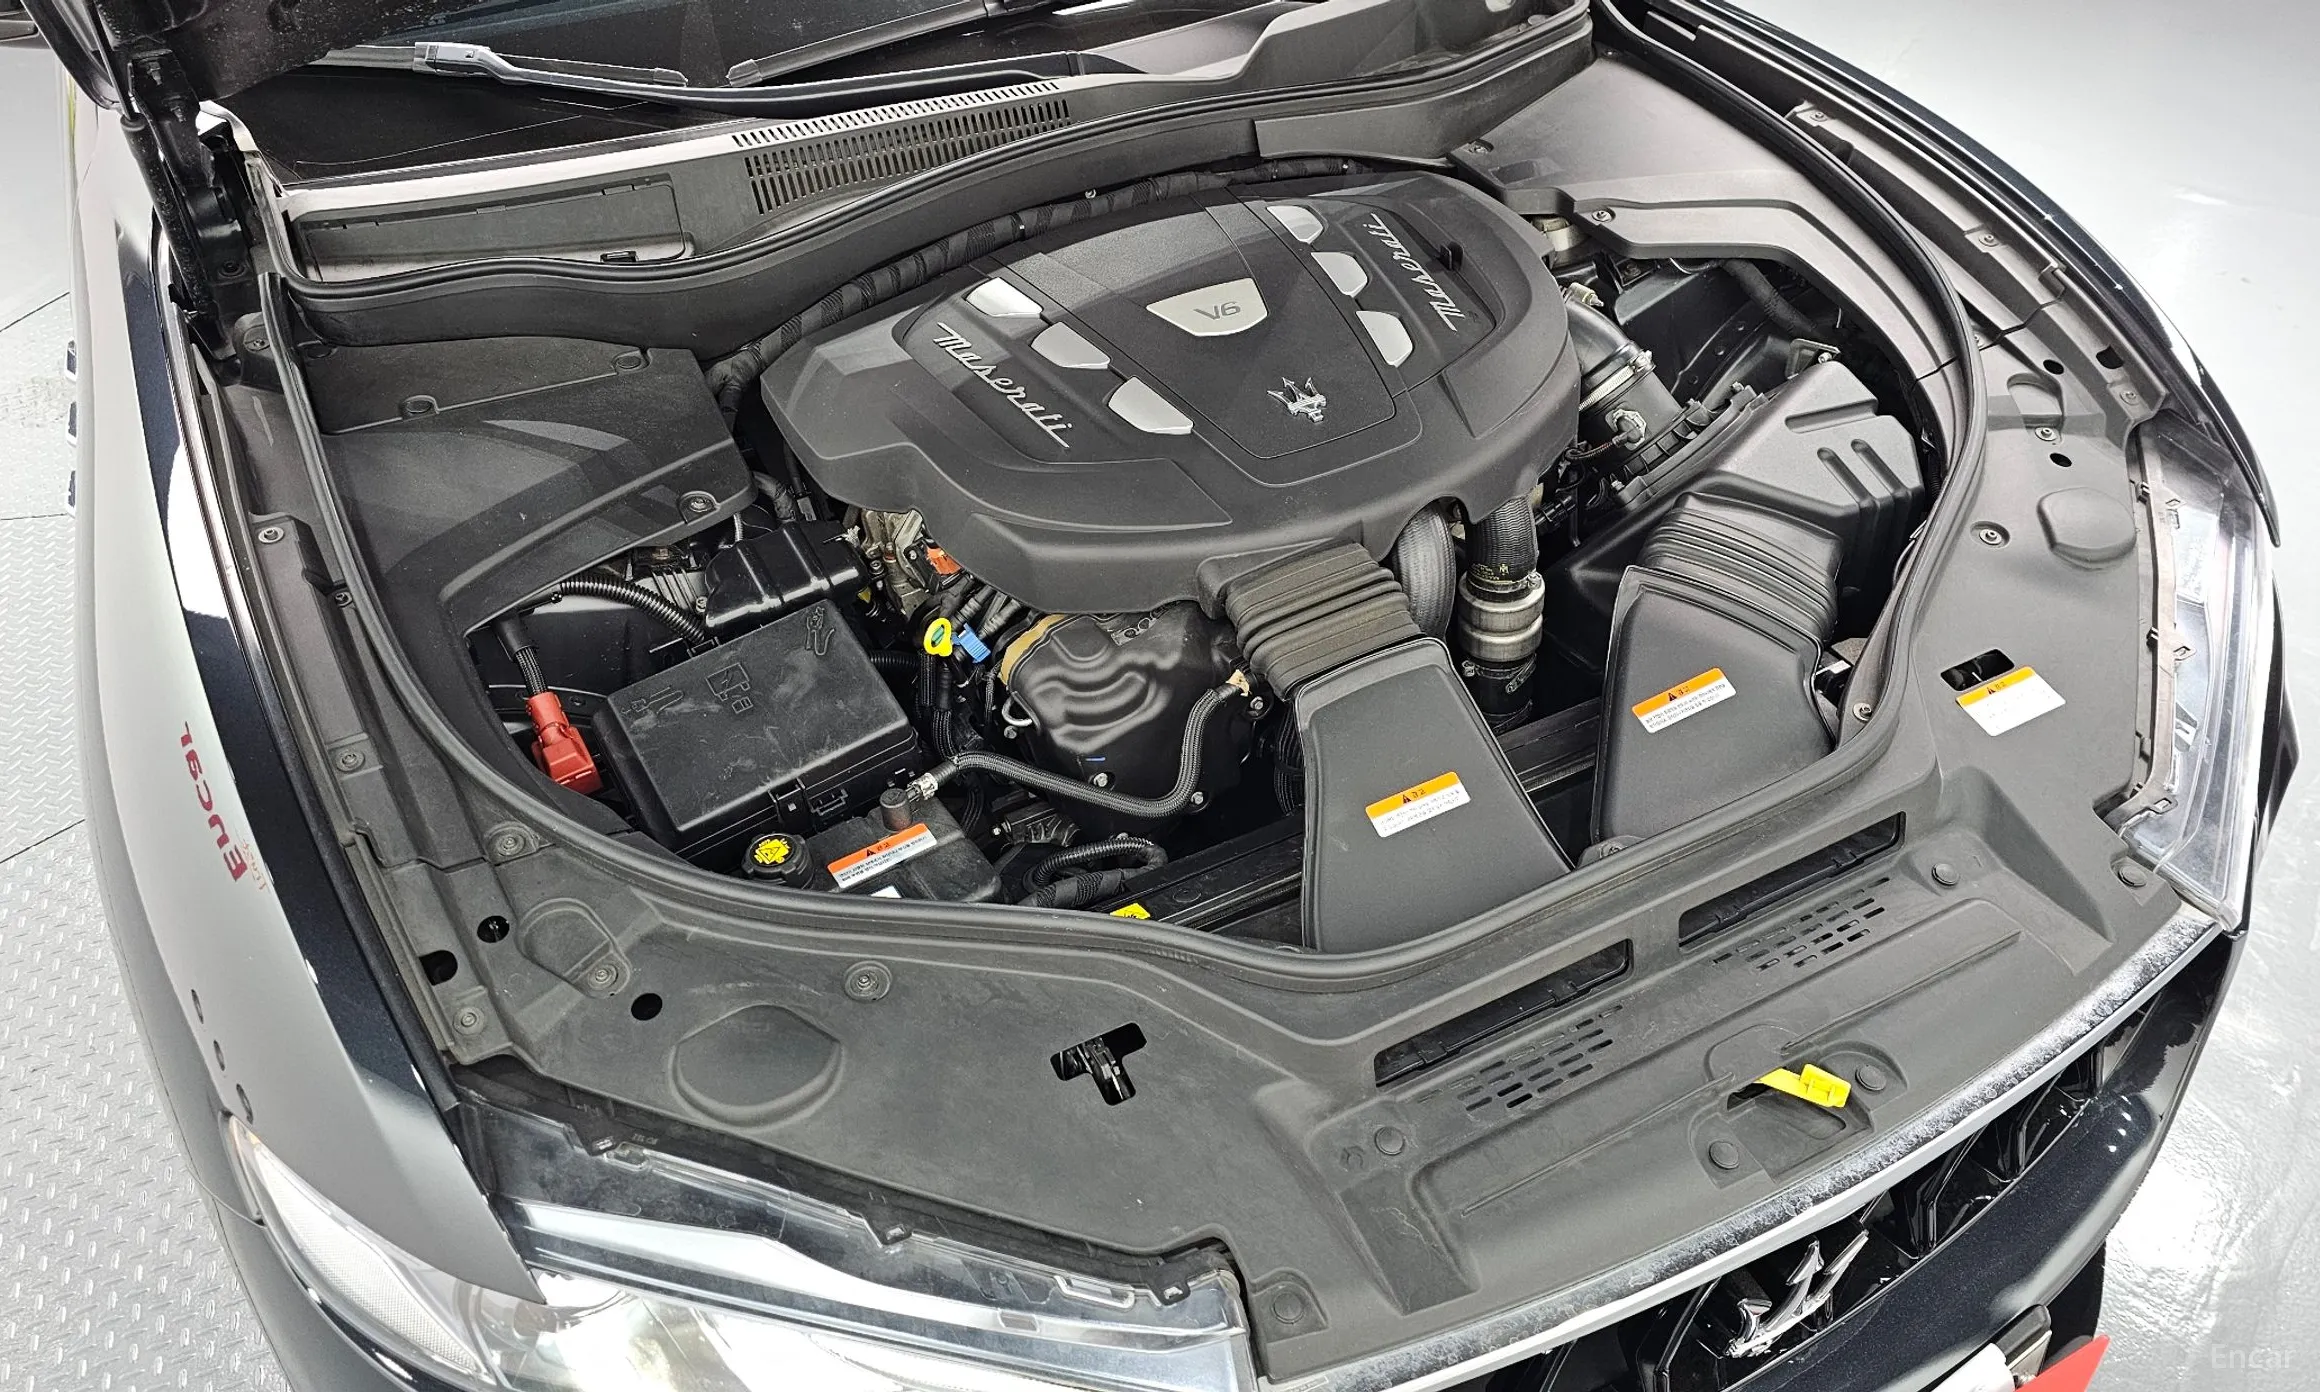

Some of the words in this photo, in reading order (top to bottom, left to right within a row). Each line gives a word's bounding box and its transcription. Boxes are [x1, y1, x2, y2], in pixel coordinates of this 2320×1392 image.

[1193, 301, 1241, 321] V6
[1362, 212, 1465, 332] Maserati
[933, 321, 1073, 448] Maserati
